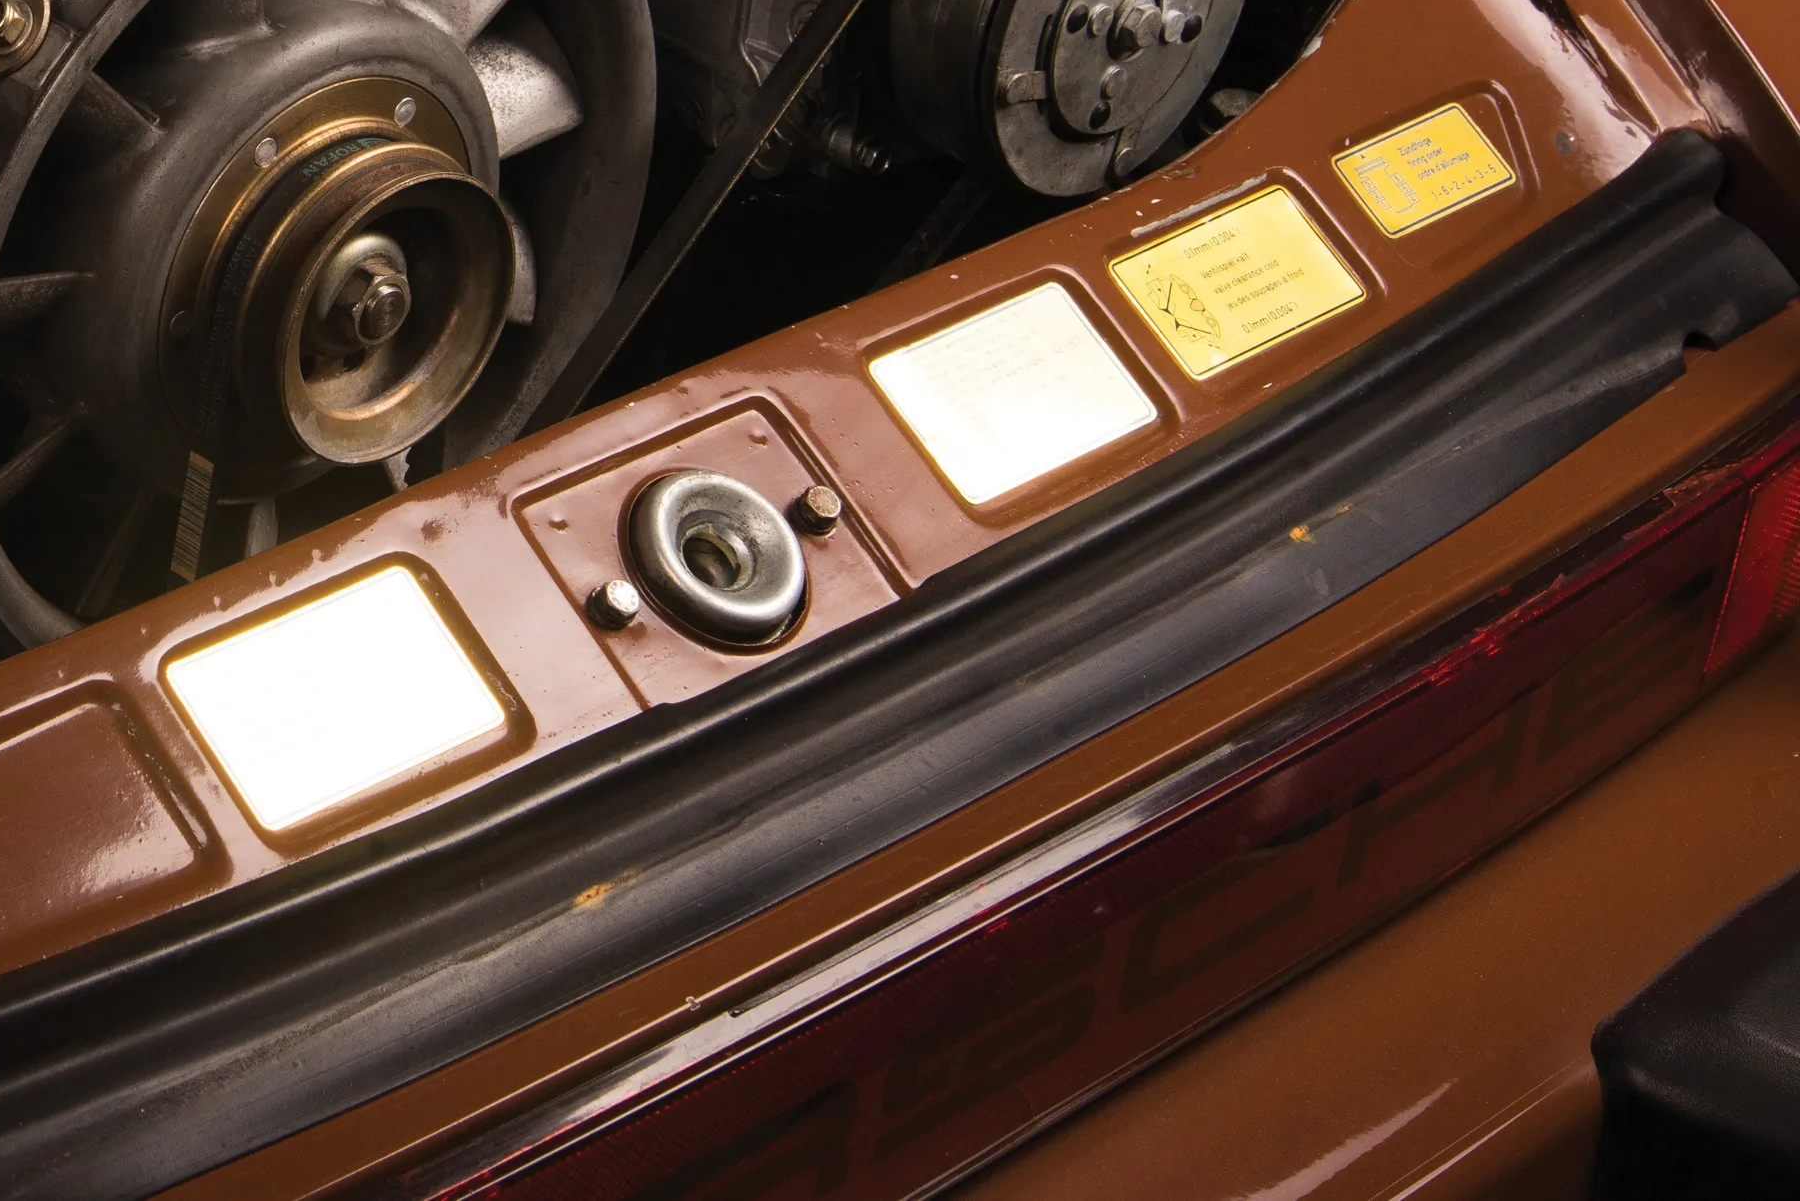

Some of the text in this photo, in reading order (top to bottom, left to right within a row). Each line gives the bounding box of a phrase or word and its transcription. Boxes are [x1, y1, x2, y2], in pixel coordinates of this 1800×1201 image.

[1427, 147, 1443, 160] order
[1417, 166, 1436, 180] ordre
[1200, 258, 1236, 280] Ventilspiel
[1214, 260, 1279, 295] valve clearance cold
[1226, 301, 1237, 312] jeu
[1238, 293, 1250, 304] des
[1250, 280, 1282, 300] soupapes
[1287, 268, 1305, 281] froid
